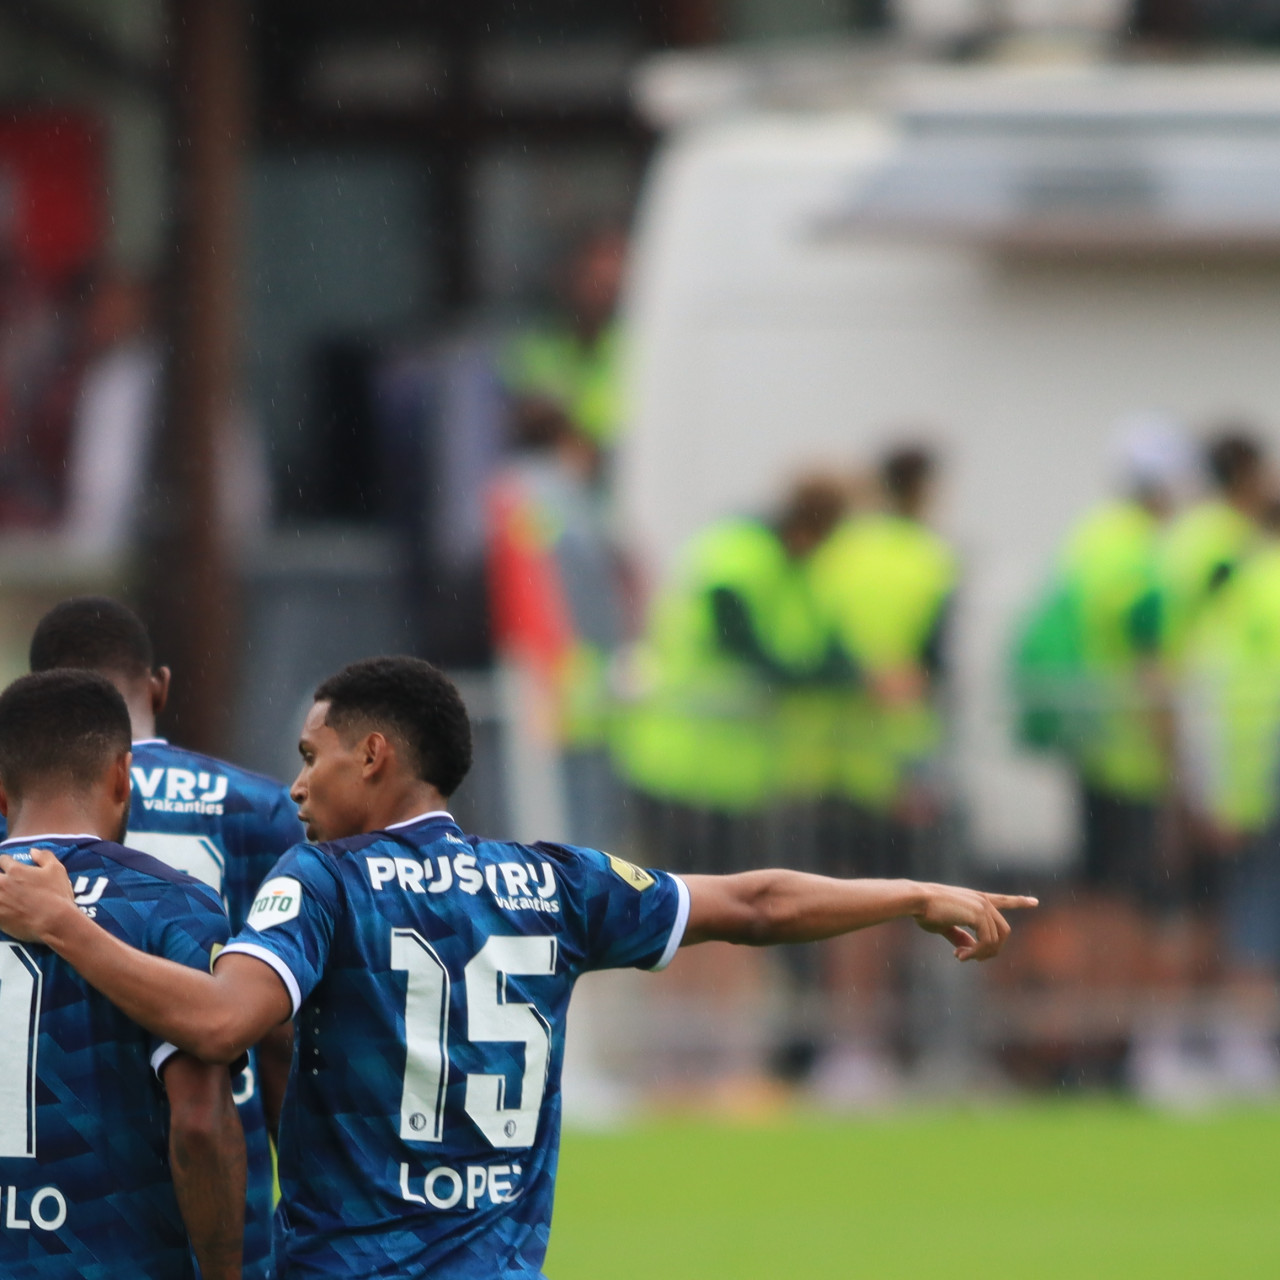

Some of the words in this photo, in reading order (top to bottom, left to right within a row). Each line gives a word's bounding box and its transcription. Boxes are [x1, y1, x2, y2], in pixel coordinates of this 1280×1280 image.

[143, 798, 224, 816] vakanties
[251, 895, 293, 917] TOTO
[390, 928, 558, 1148] 15
